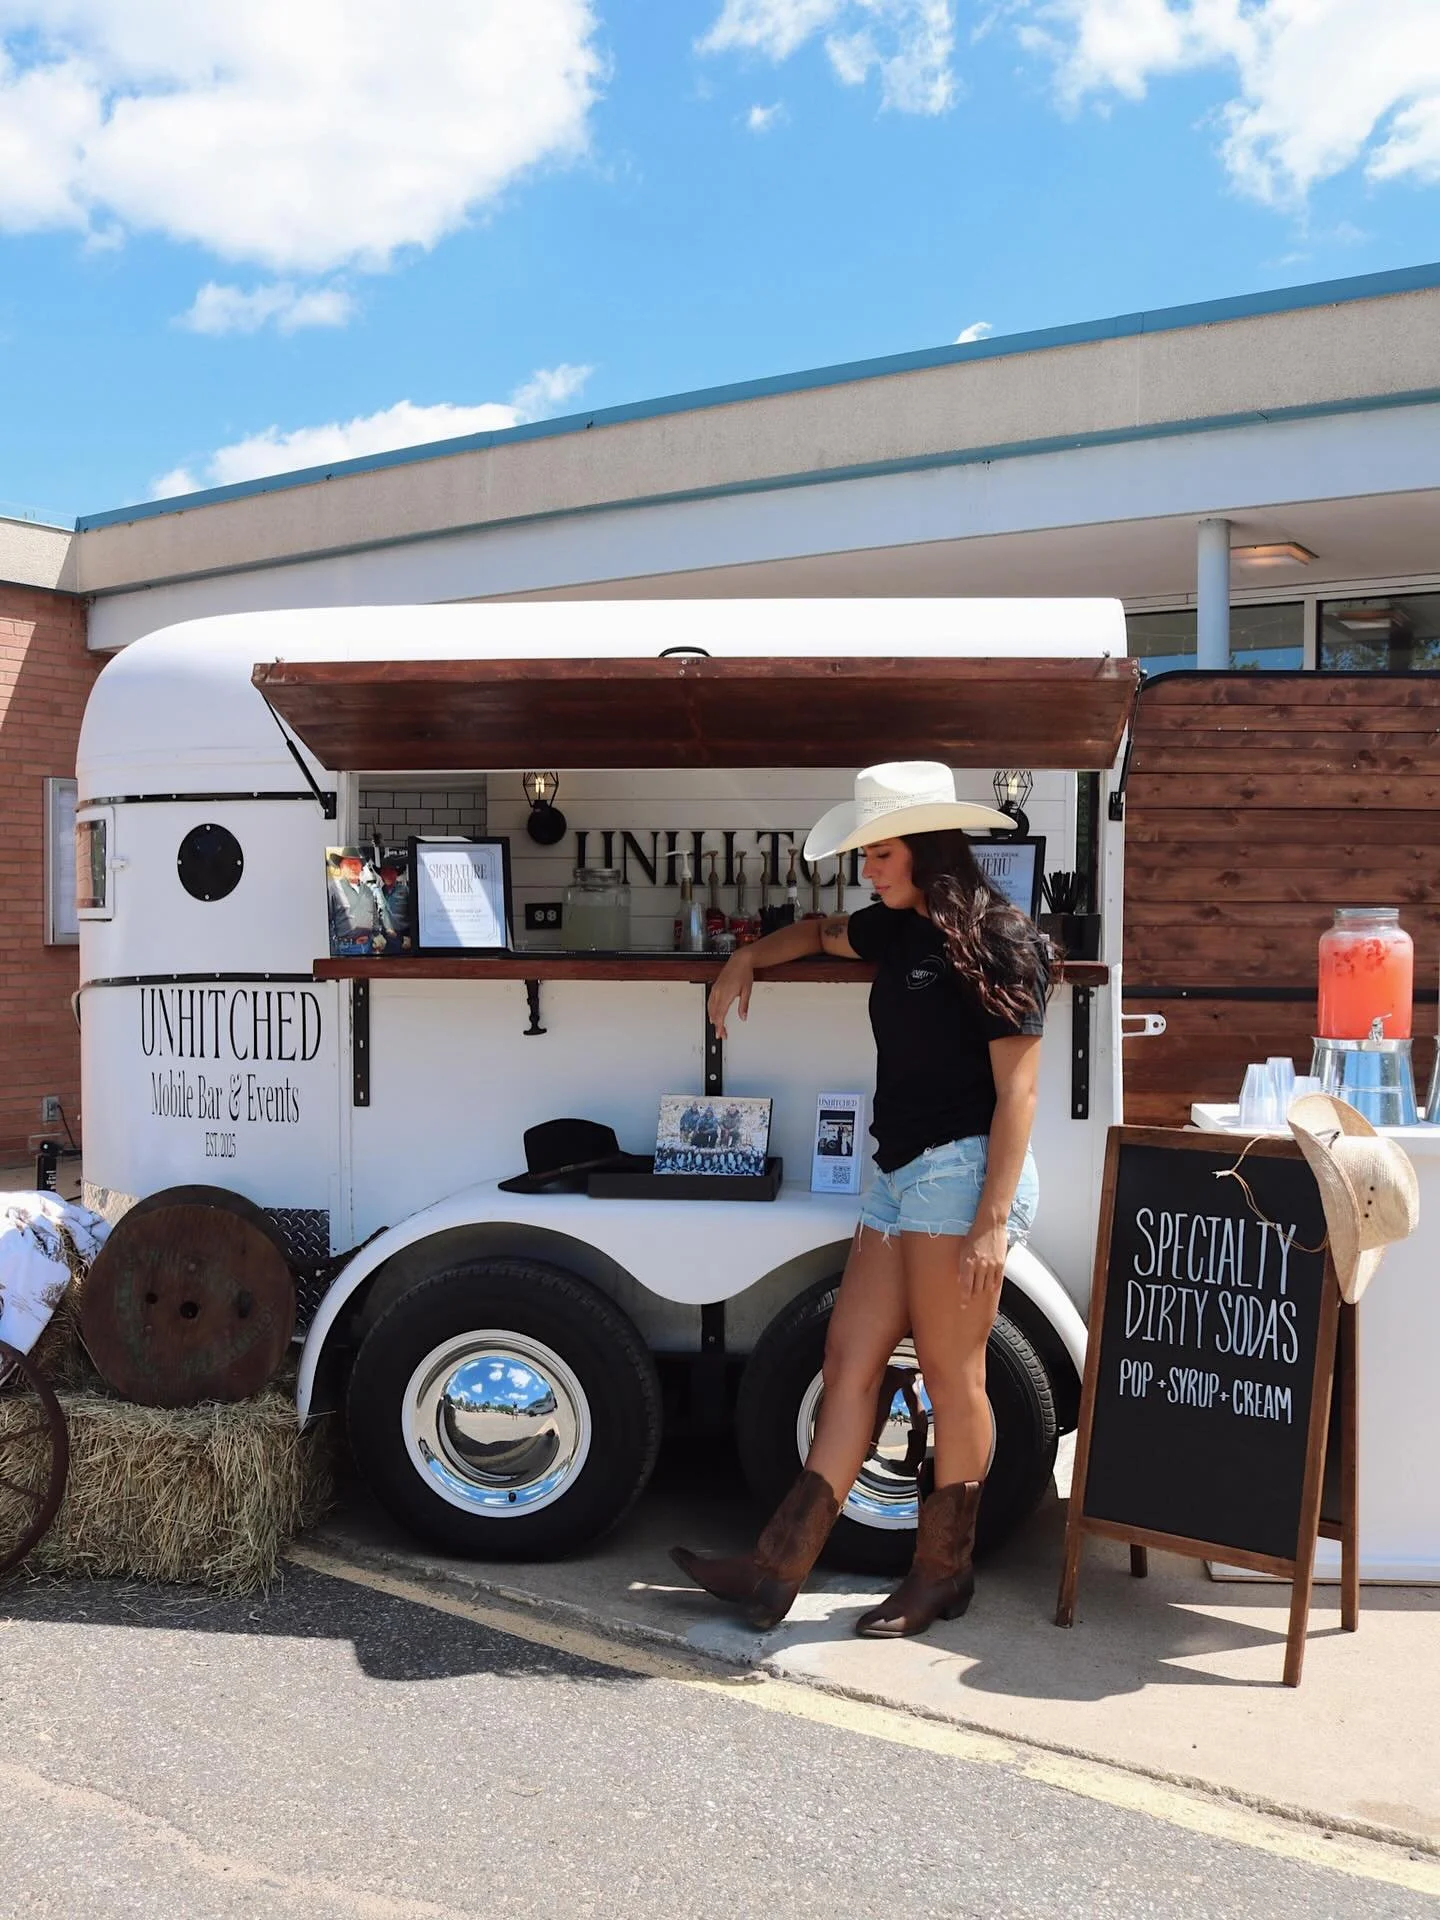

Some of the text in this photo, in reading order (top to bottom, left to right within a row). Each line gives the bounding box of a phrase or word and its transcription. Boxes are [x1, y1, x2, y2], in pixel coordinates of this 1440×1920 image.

[429, 864, 488, 880] SIGNATURE
[442, 879, 474, 894] DRINK
[140, 988, 322, 1061] UNHITCHED
[151, 1069, 300, 1123] Mobile Bar & Events
[220, 1133, 236, 1158] 2025
[1133, 1207, 1297, 1295] SPECIALTY
[1125, 1280, 1299, 1364] DIRTY SODAS
[1119, 1358, 1154, 1398] POP
[1232, 1379, 1293, 1425] CREAM
